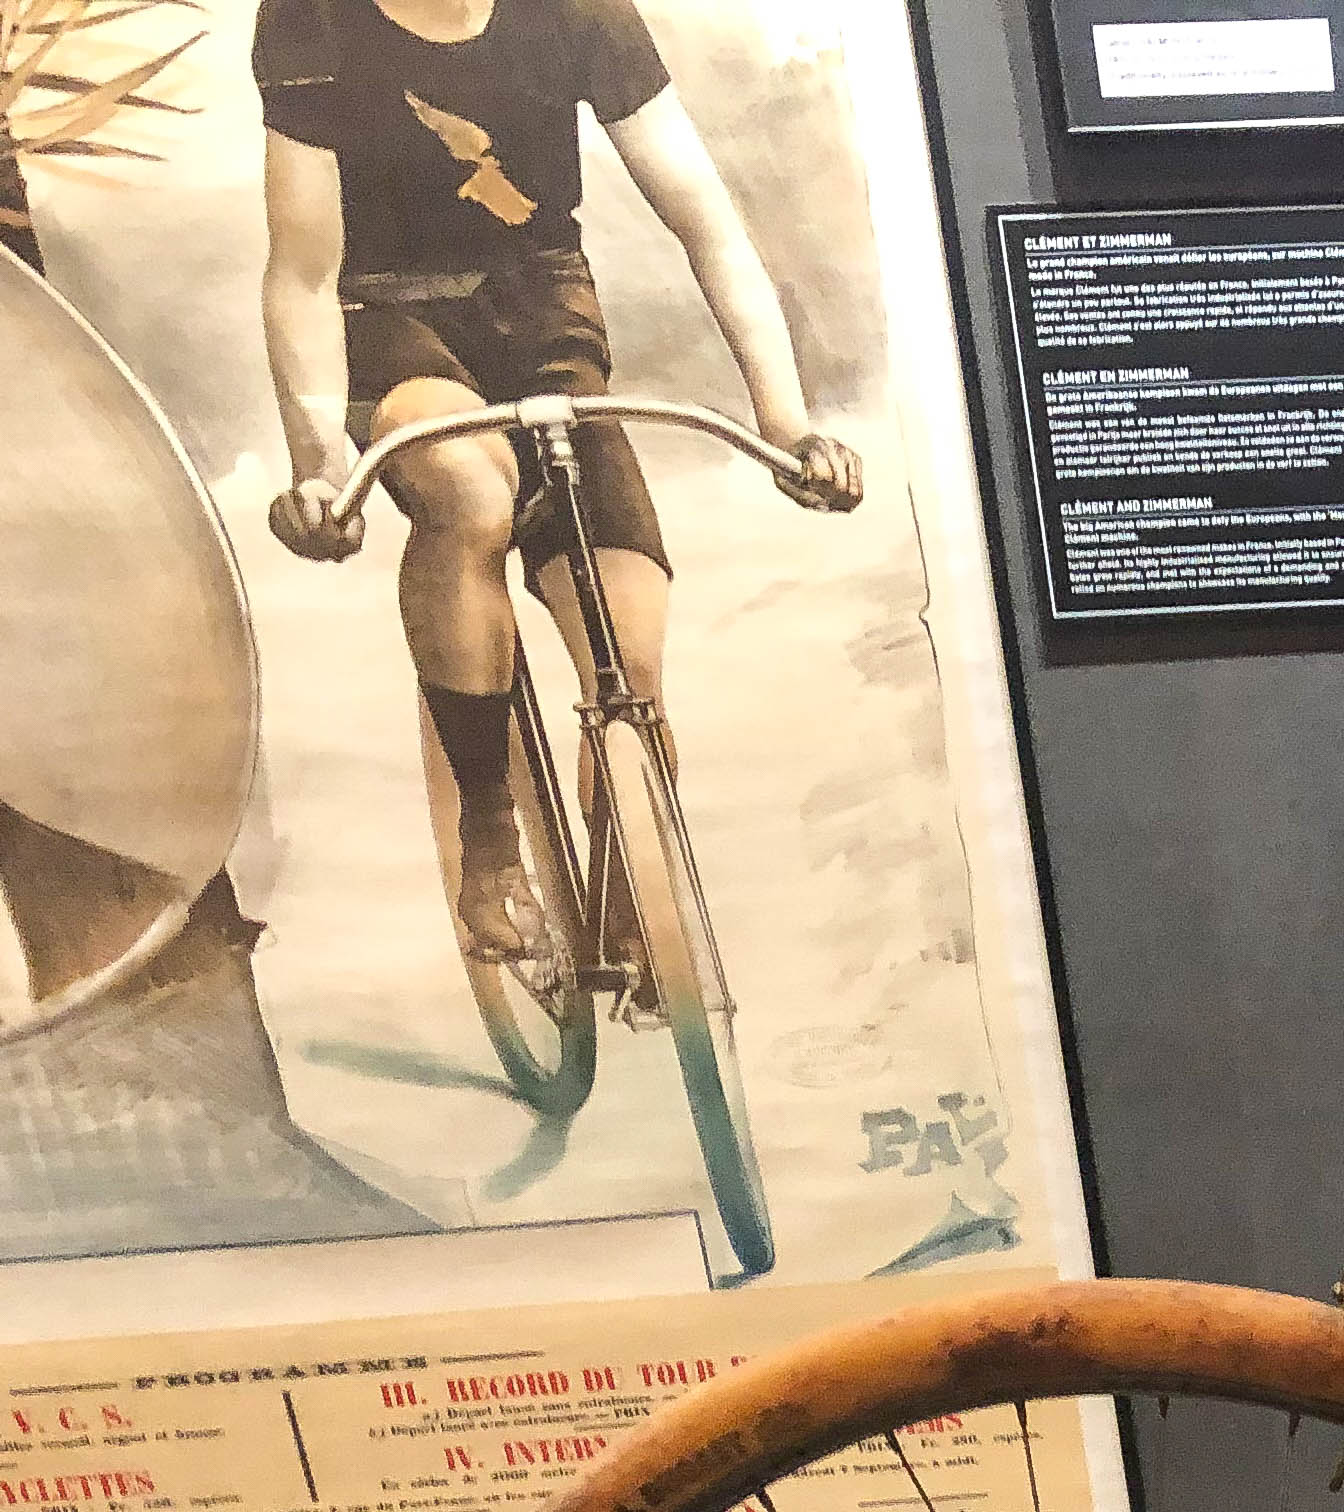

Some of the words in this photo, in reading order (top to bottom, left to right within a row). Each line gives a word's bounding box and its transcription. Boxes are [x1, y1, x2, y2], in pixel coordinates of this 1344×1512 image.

[1023, 233, 1079, 250] CLÉMENT
[1081, 234, 1097, 248] ET
[1098, 232, 1171, 248] ZIMMERMAN
[1042, 369, 1097, 385] CLÉMENT
[1099, 369, 1116, 383] EN
[1117, 366, 1189, 382] ZIMMERMAN
[1059, 500, 1113, 515] CLÉMENT
[1116, 498, 1140, 513] AND
[1142, 495, 1212, 512] ZIMMERMAN
[132, 1355, 428, 1391] PROGRAMME
[380, 1380, 428, 1409] III.
[446, 1371, 570, 1403] RECORD
[583, 1365, 623, 1392] DU
[637, 1359, 718, 1387] TOUR
[443, 1445, 485, 1472] IV.
